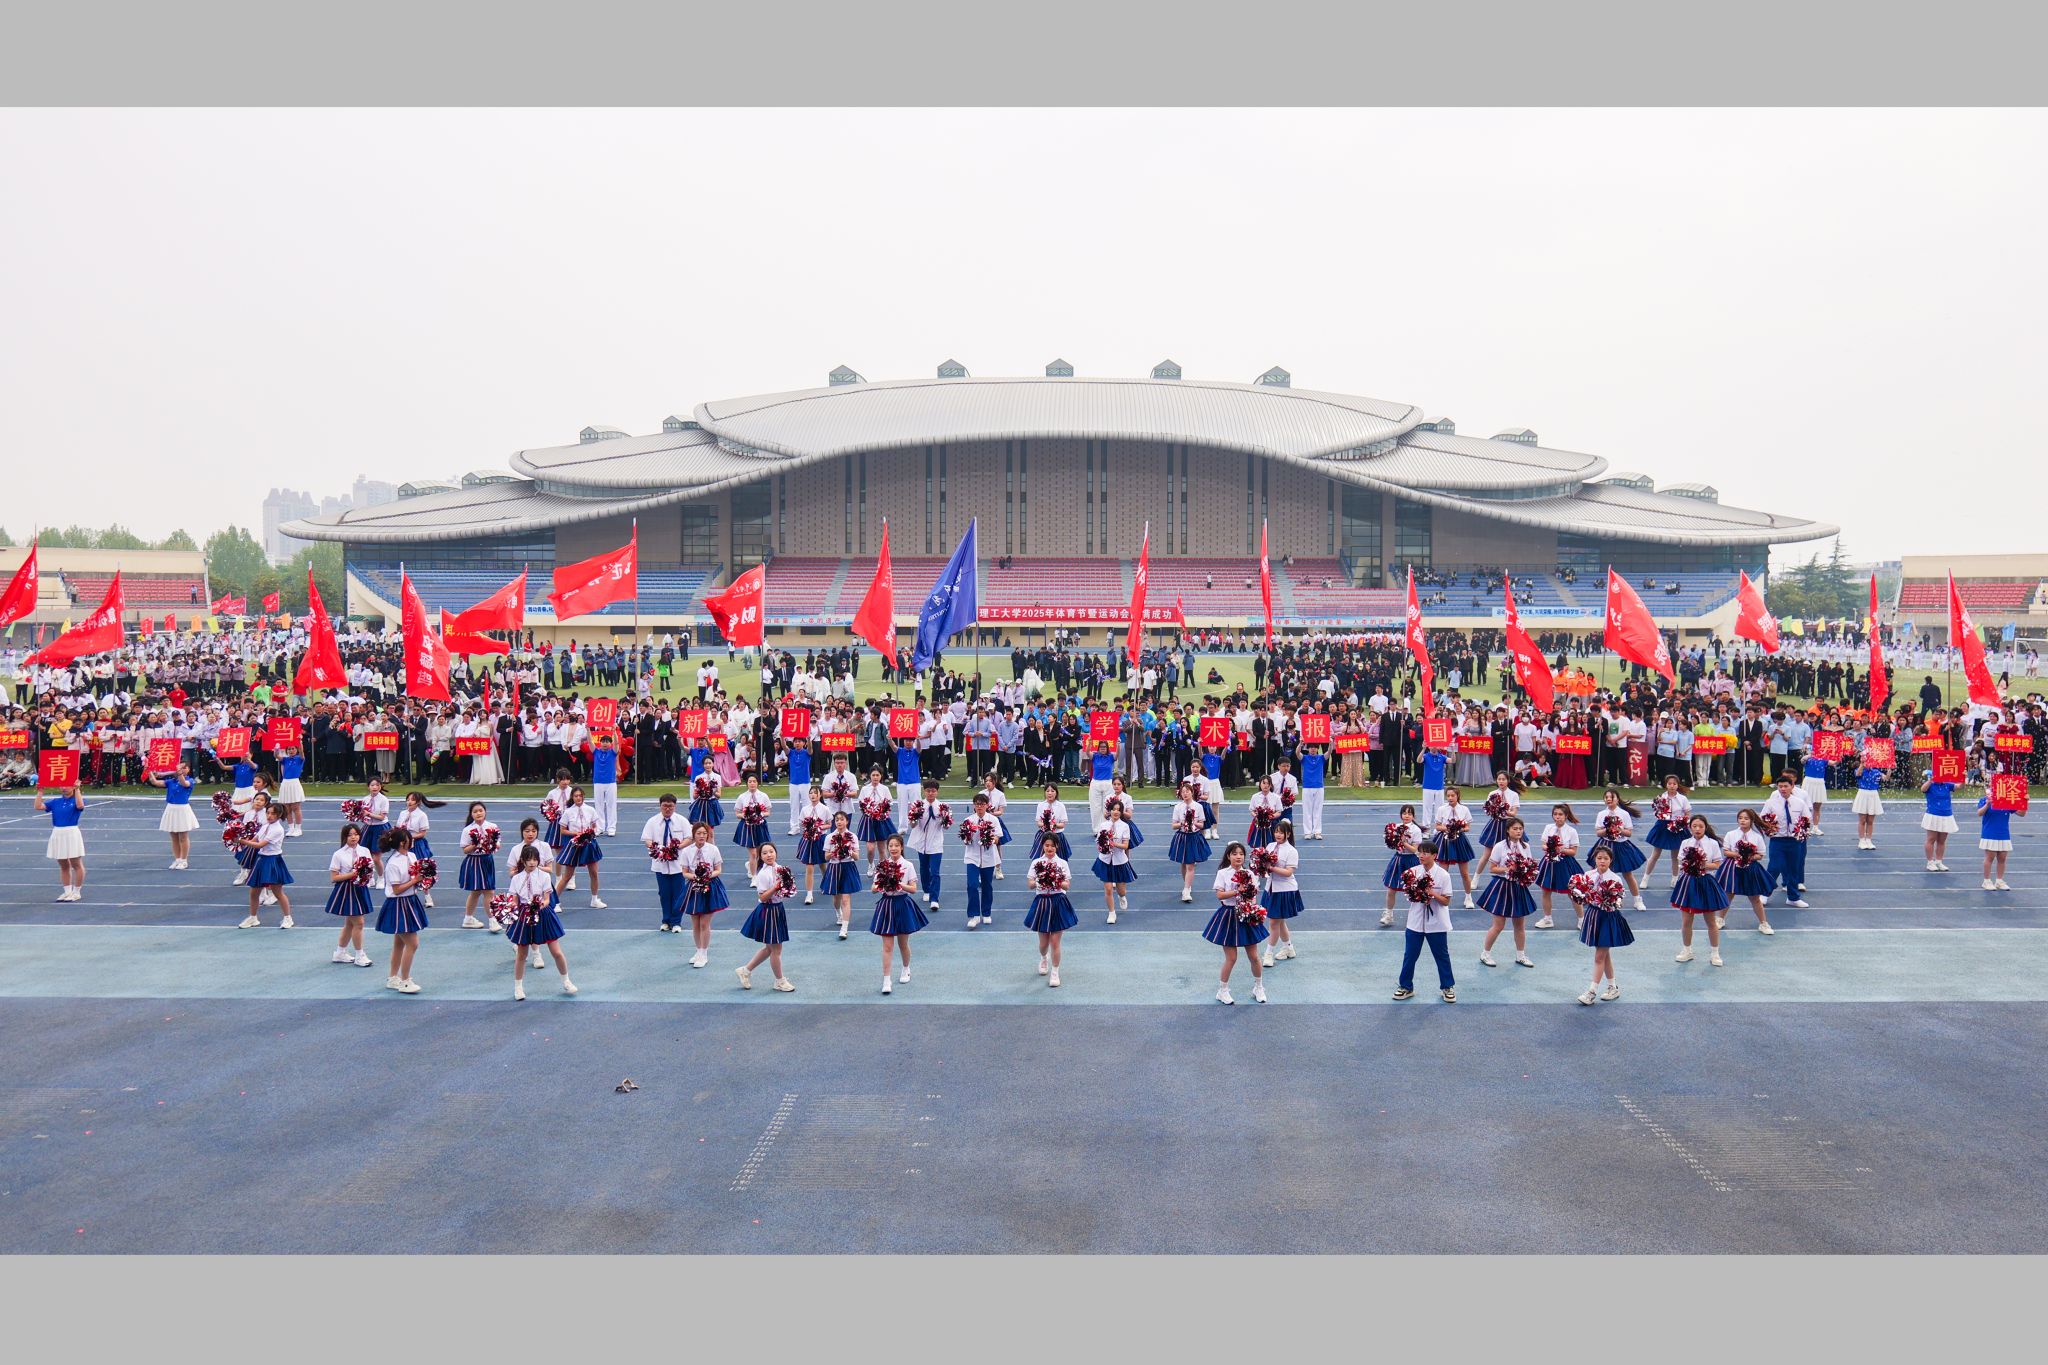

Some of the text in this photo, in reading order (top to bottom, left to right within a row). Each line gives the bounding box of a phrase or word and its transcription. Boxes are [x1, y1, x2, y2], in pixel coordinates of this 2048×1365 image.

[979, 608, 1172, 619] 理工大学2025年体育节暨运动会满成功
[592, 702, 611, 723] 创
[787, 712, 804, 733] 引
[894, 712, 914, 732] 领
[275, 721, 294, 742] 当
[683, 713, 703, 734] 新
[1095, 715, 1114, 736] 学
[1204, 721, 1225, 742] 术
[1305, 718, 1326, 739] 报
[1428, 722, 1448, 742] 国
[223, 732, 244, 753] 担
[458, 741, 489, 751] 电气学院
[824, 737, 854, 746] 安全学院
[1337, 738, 1368, 749] 创新创业学院
[1460, 739, 1492, 750] 工商学院
[1558, 740, 1589, 750] 化工学院
[1694, 740, 1724, 750] 机械学院
[1820, 735, 1837, 756] 勇
[1870, 740, 1890, 763] 攀
[1997, 737, 2030, 748] 能源学院
[155, 743, 175, 766] 春
[47, 754, 71, 782] 青
[1938, 754, 1959, 778] 高
[1996, 779, 2021, 805] 峰
